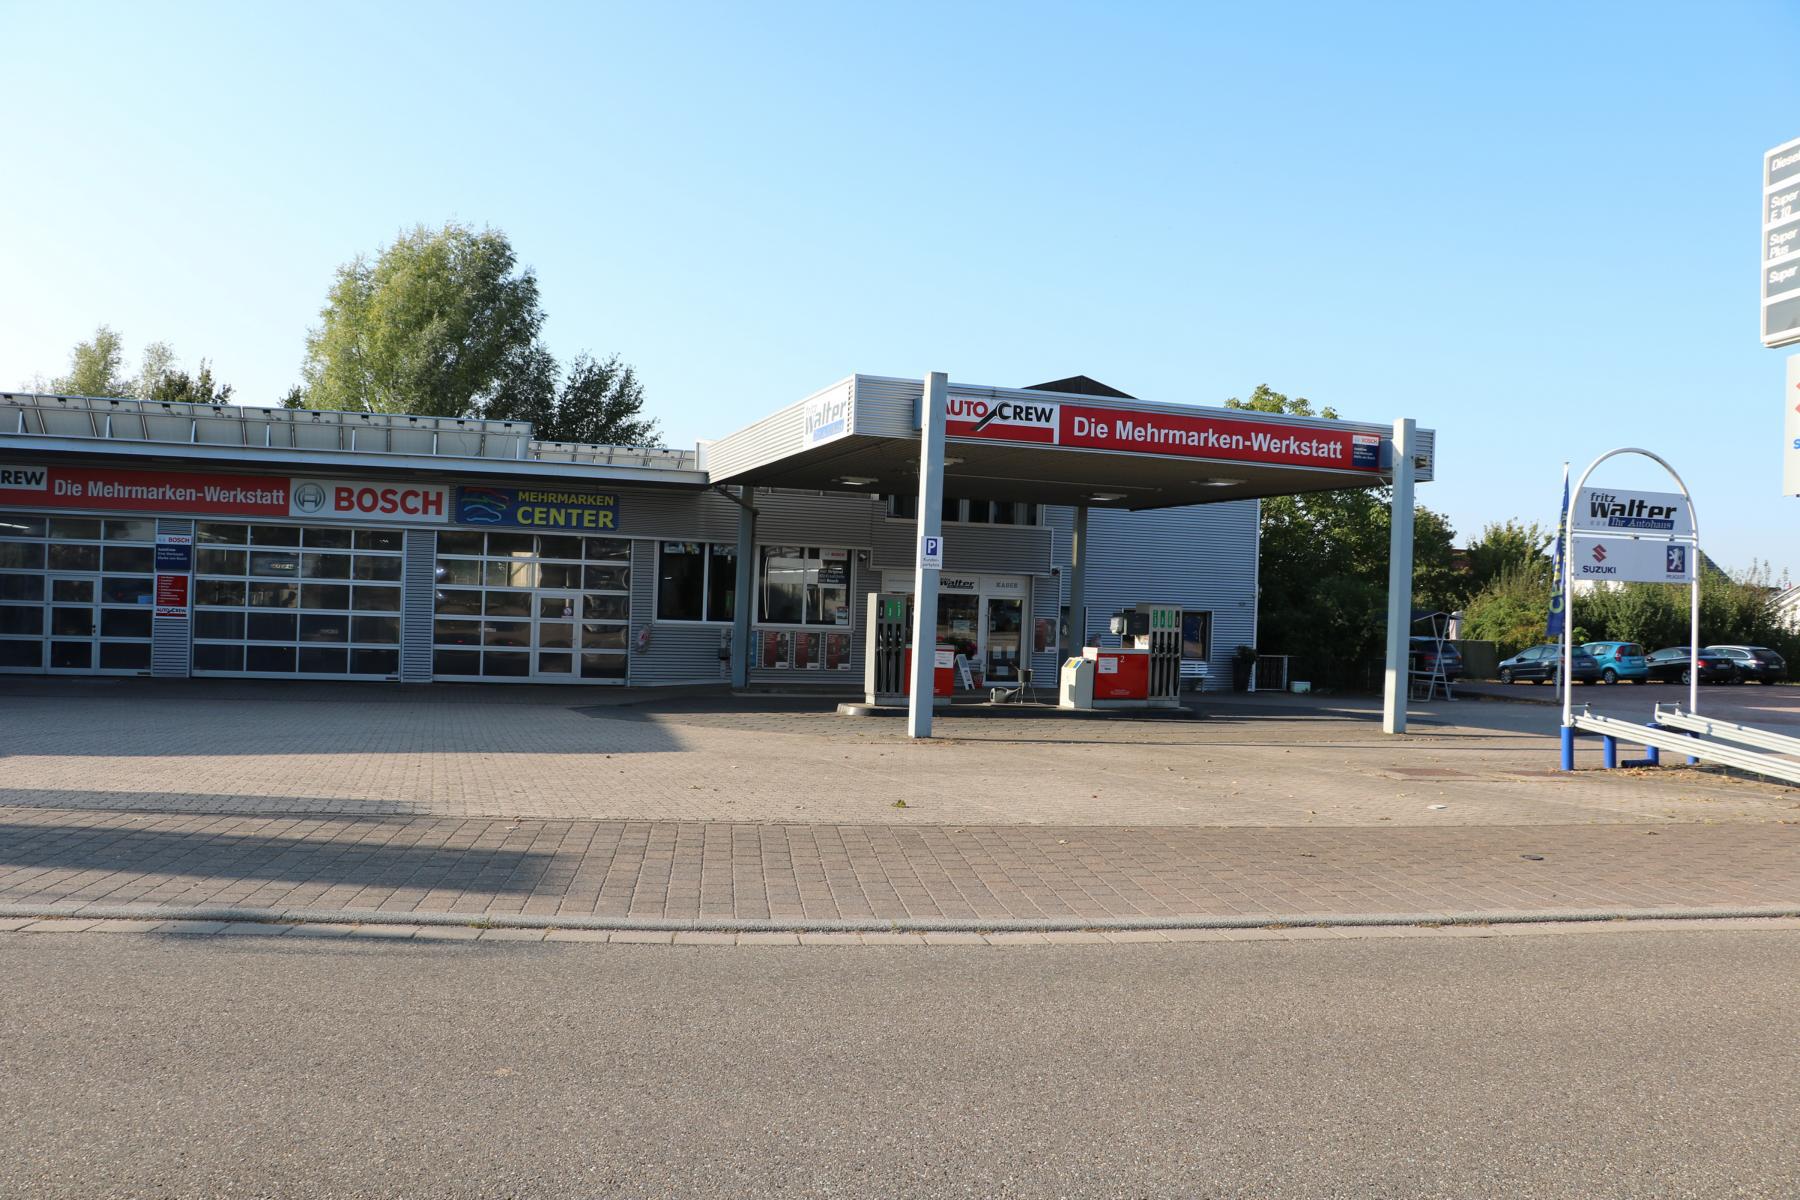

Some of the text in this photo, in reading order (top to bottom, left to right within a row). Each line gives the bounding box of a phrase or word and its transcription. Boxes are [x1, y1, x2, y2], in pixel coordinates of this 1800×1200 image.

[1771, 191, 1798, 208] Super
[1770, 229, 1798, 246] Super
[1770, 245, 1789, 259] Plus
[1769, 266, 1798, 284] Super
[998, 403, 1054, 423] CREW
[1073, 416, 1343, 460] Die Mehrmarken-Werkstatt
[54, 479, 82, 497] Die
[88, 481, 285, 505] Mehrmarken-Werkstatt
[335, 486, 443, 515] BOSCH
[518, 491, 614, 506] MEHRMARKEN
[1590, 493, 1616, 503] fritz
[517, 506, 615, 528] CENTER
[1611, 518, 1672, 530] Ihr Autohaus
[1583, 565, 1617, 574] SUZUKI
